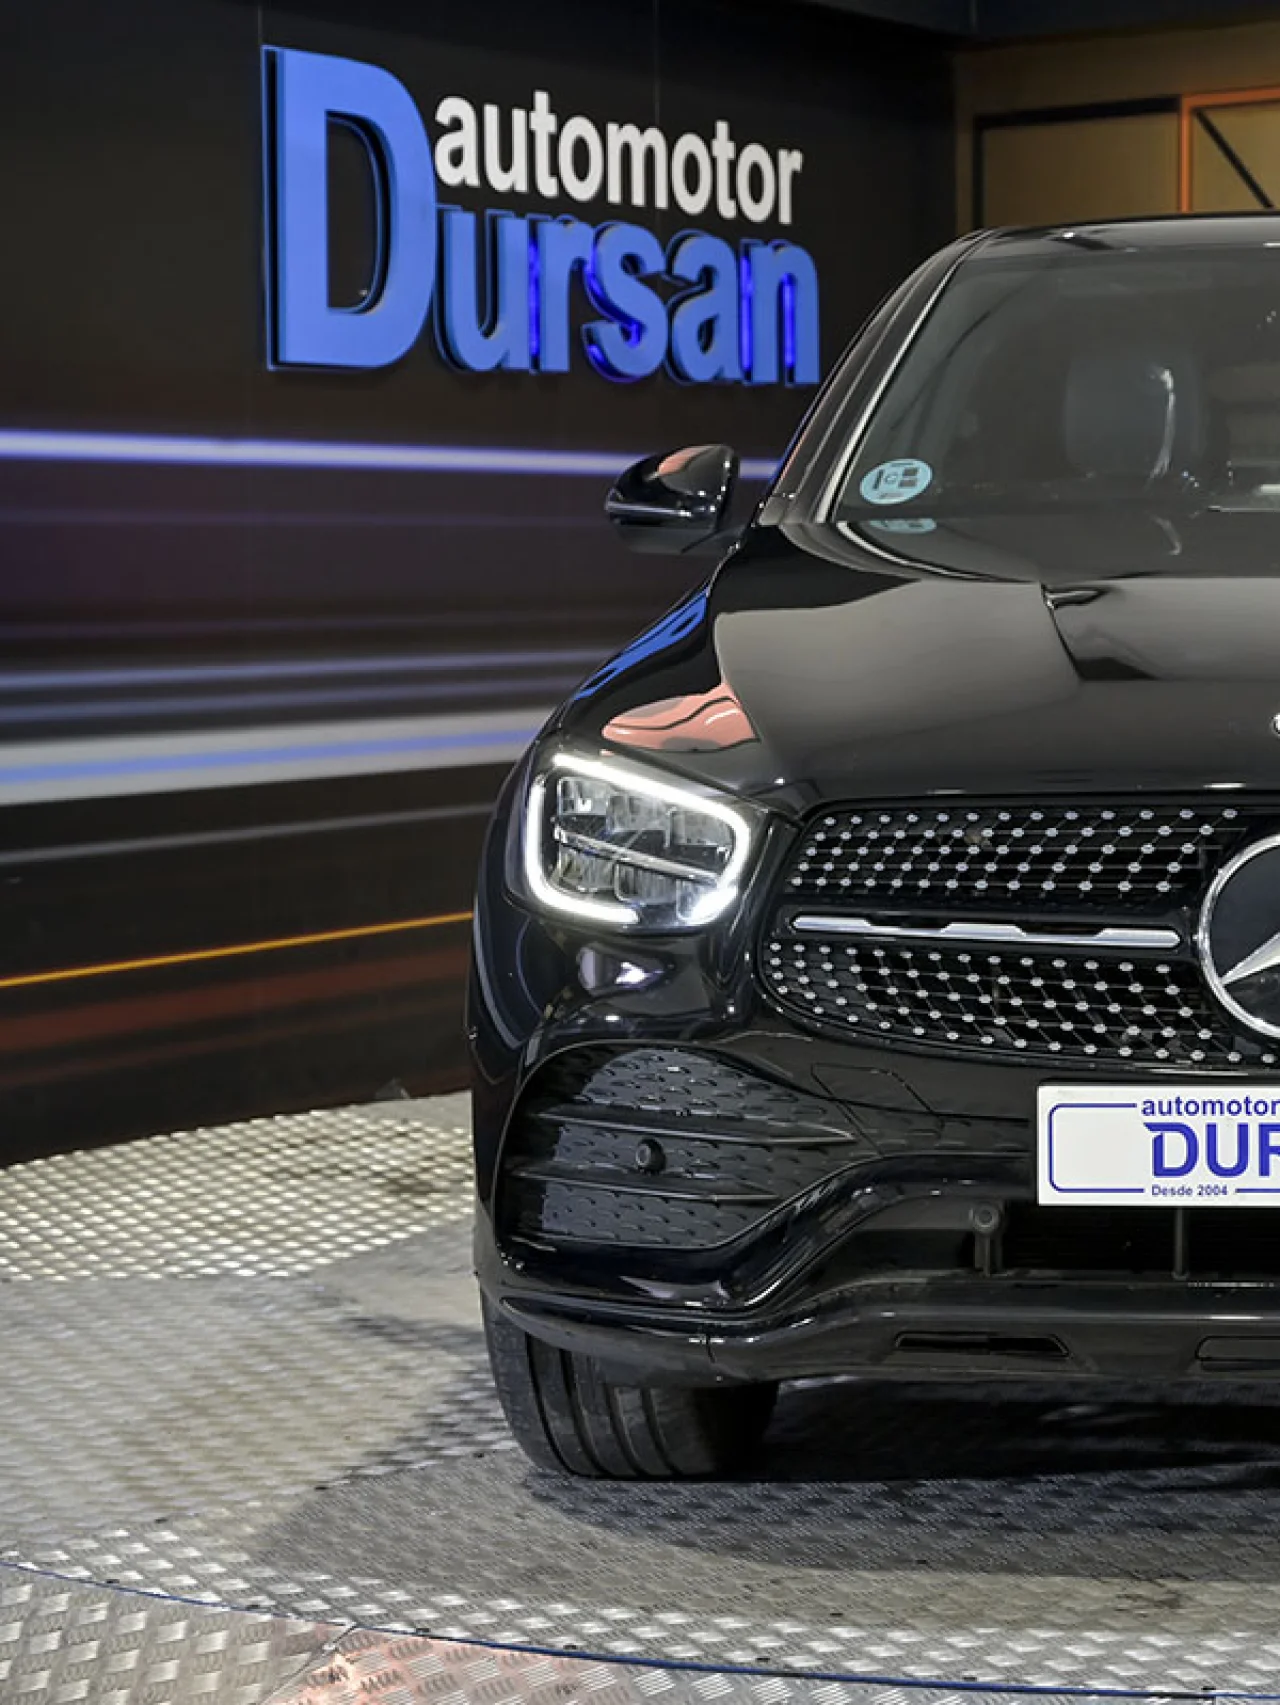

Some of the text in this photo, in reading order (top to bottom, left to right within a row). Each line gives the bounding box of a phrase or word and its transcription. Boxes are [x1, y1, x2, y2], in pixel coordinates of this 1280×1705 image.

[434, 90, 803, 225] automotor
[261, 44, 820, 386] Dursan
[1141, 1096, 1280, 1117] automotor
[1151, 1183, 1228, 1197] Desde 2004
